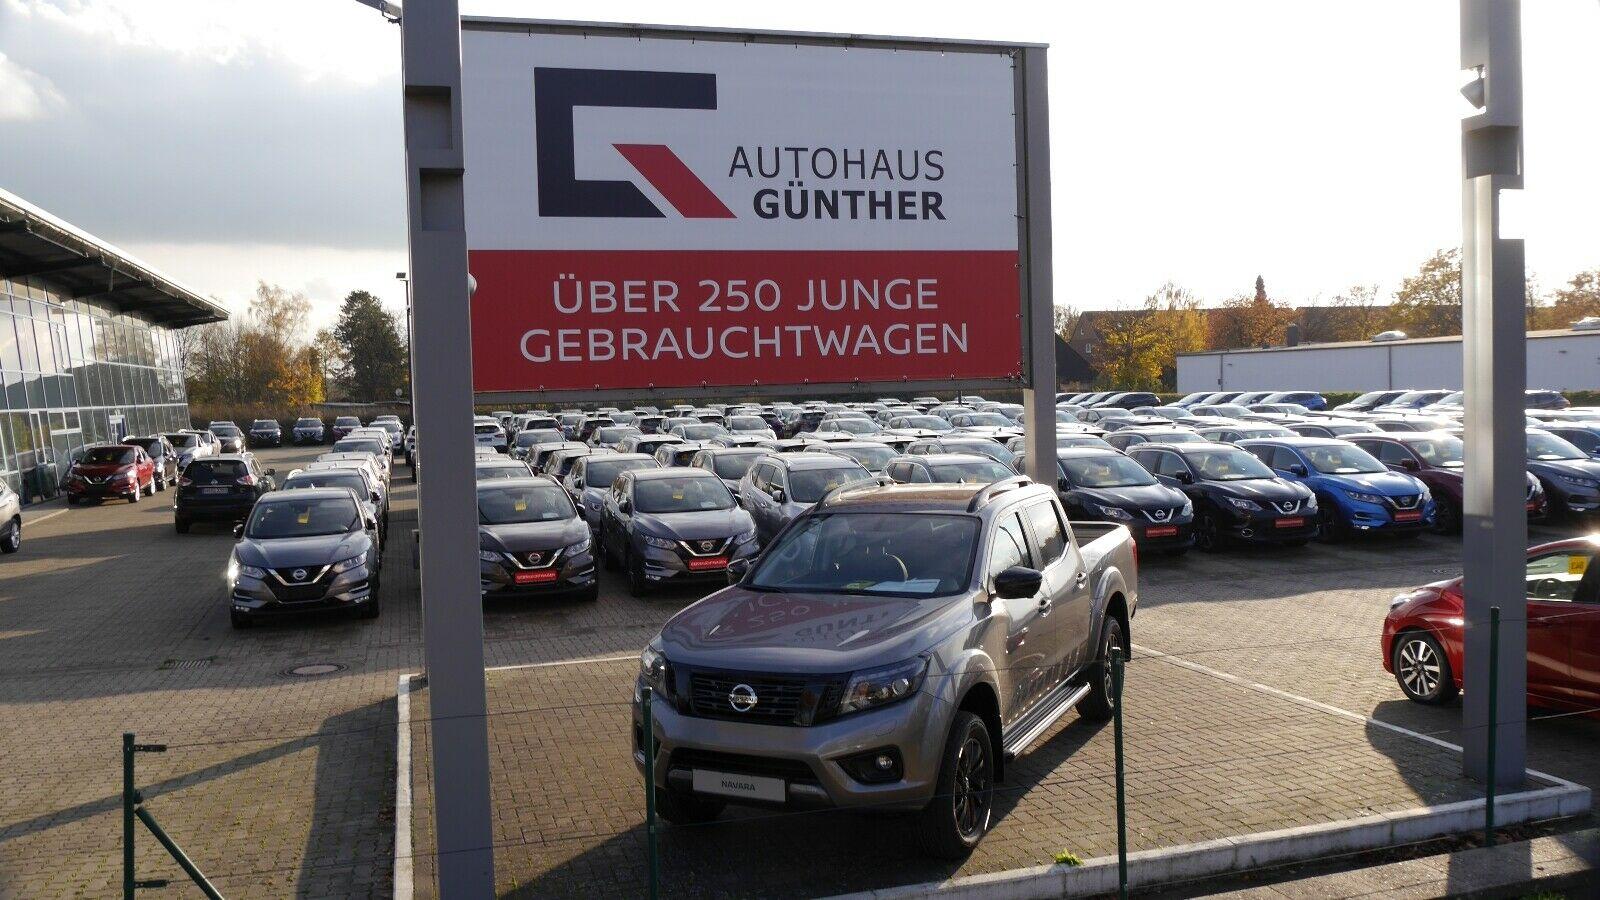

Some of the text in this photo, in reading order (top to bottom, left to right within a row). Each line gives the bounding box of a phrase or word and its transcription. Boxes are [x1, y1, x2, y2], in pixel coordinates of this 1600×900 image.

[729, 145, 945, 182] AUTOHAUS
[753, 181, 947, 220] GÜNTHER
[553, 273, 938, 314] ÜBER 250 JUNGE
[520, 322, 968, 363] GEBRAUCHTWAGEN
[721, 780, 756, 791] NAVARA
